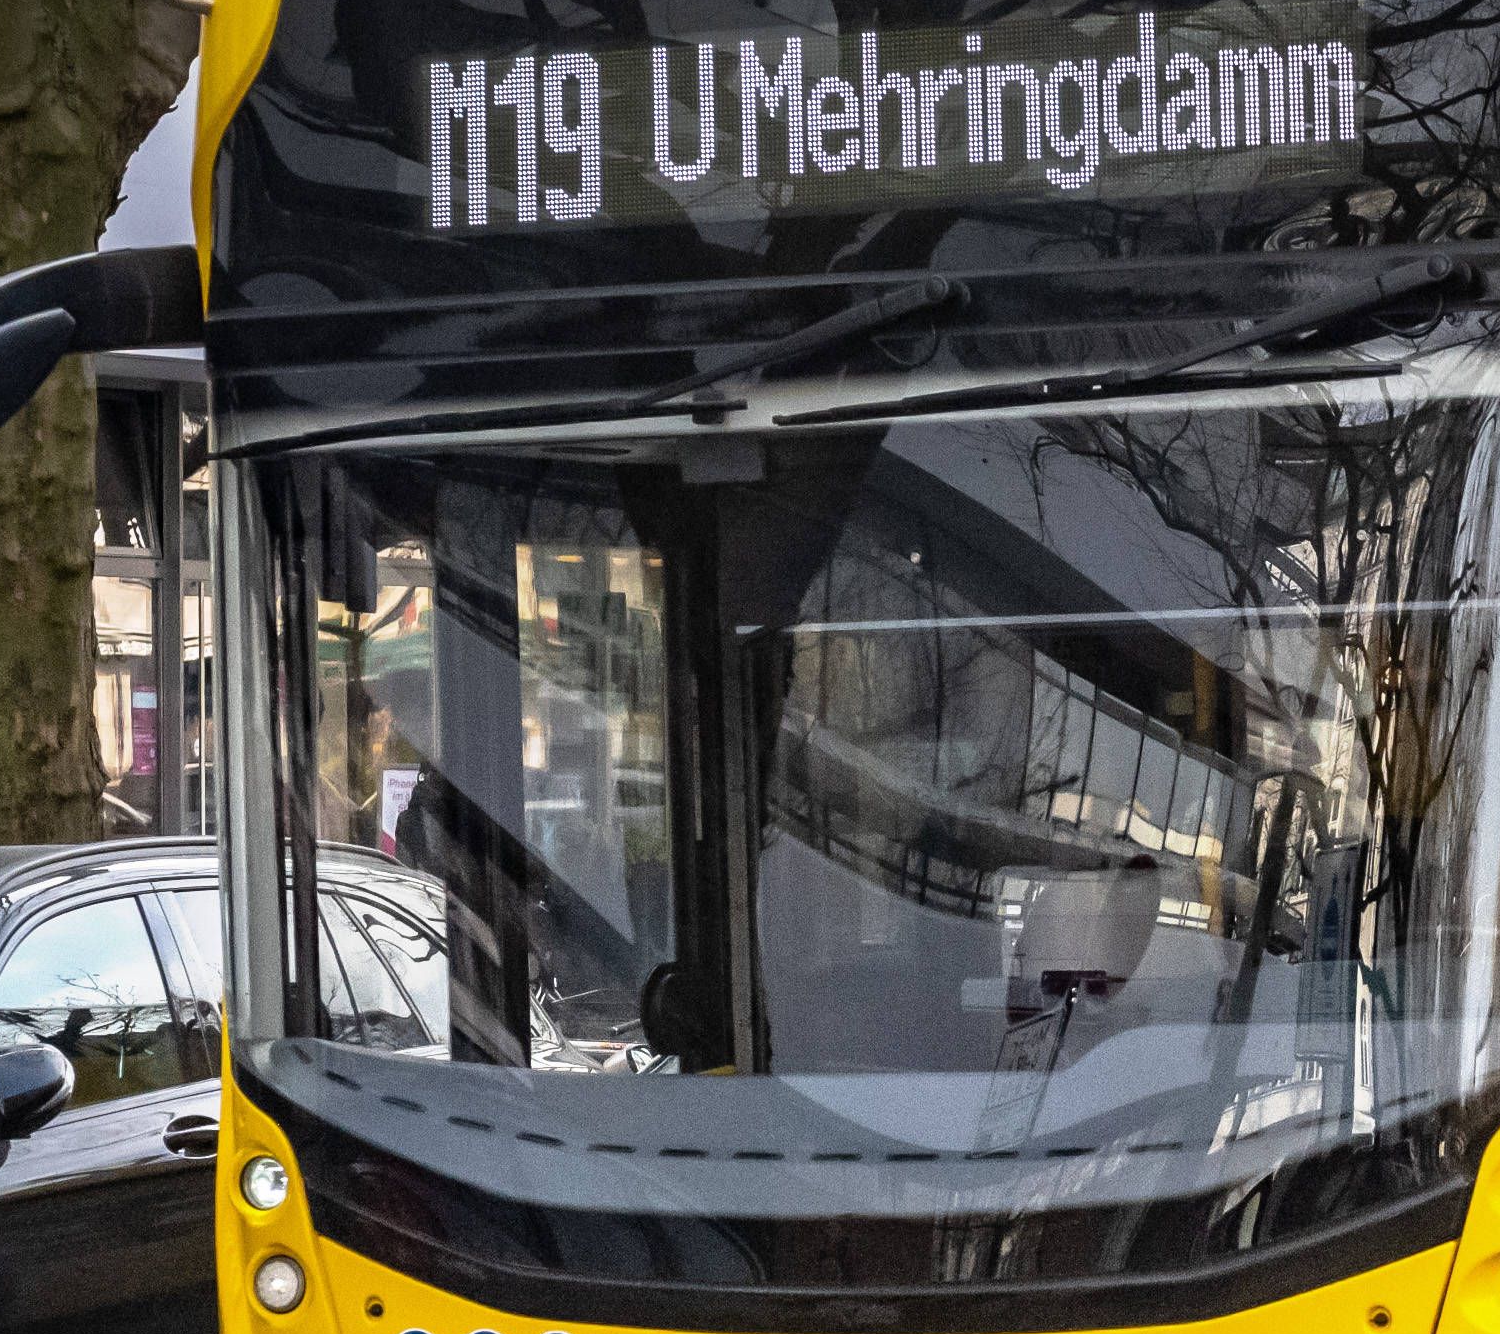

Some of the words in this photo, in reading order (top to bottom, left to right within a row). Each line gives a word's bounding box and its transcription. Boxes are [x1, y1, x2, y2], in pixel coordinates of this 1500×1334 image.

[431, 52, 601, 227] M19
[653, 43, 715, 181] U
[740, 11, 1356, 189] Mehringdamm
